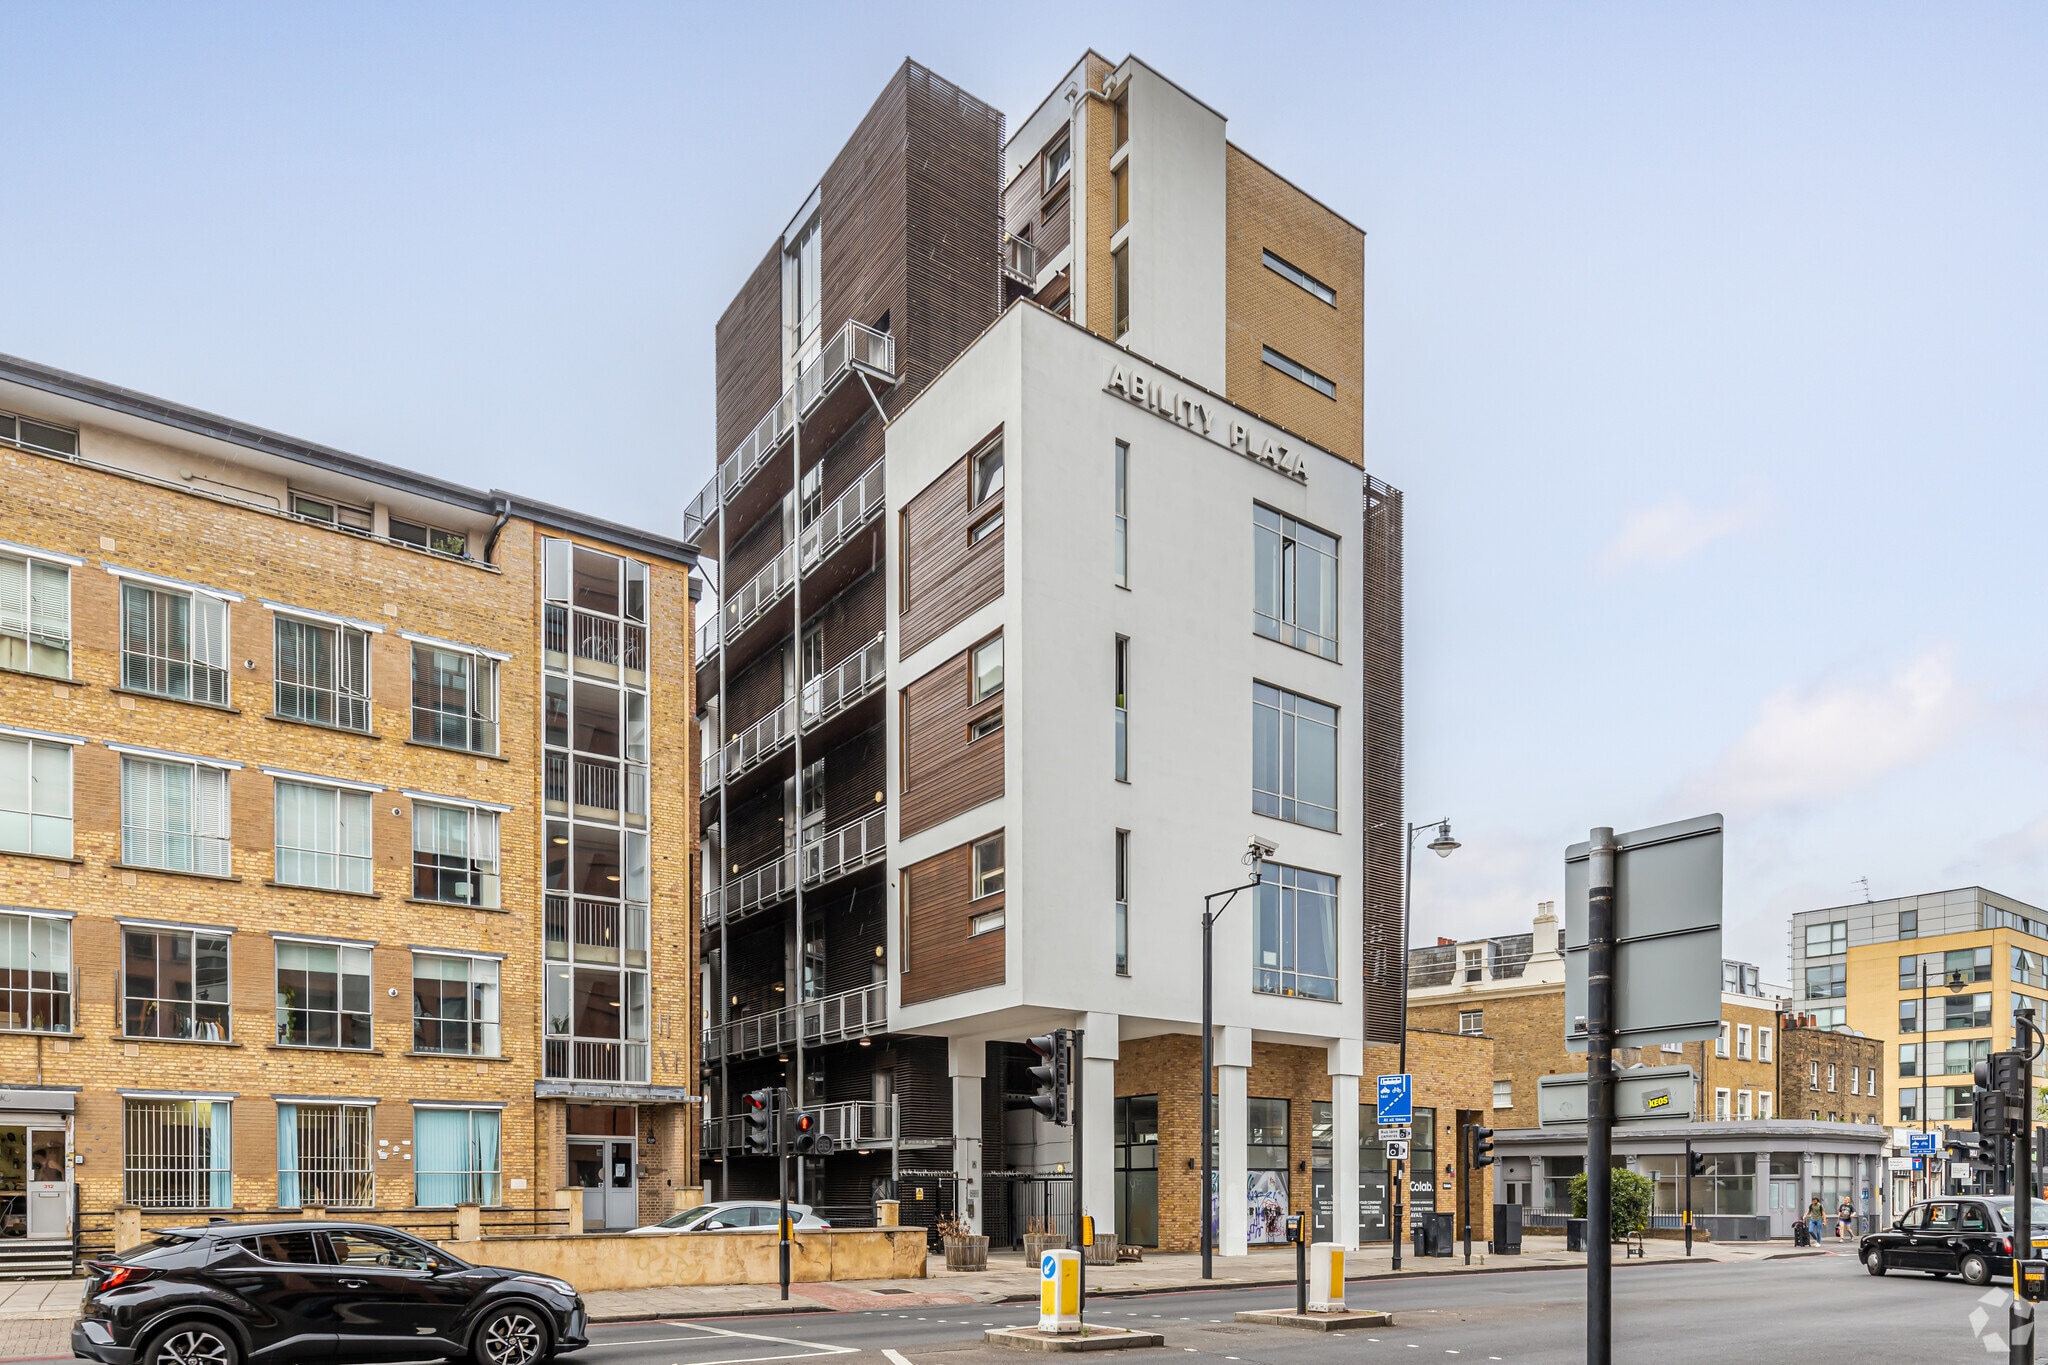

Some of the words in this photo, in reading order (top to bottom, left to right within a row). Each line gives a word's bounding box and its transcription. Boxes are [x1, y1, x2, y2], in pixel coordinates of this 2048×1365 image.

[1107, 364, 1214, 434] ABILITY
[1229, 420, 1308, 481] PLAZA
[1410, 1181, 1434, 1191] Colab.
